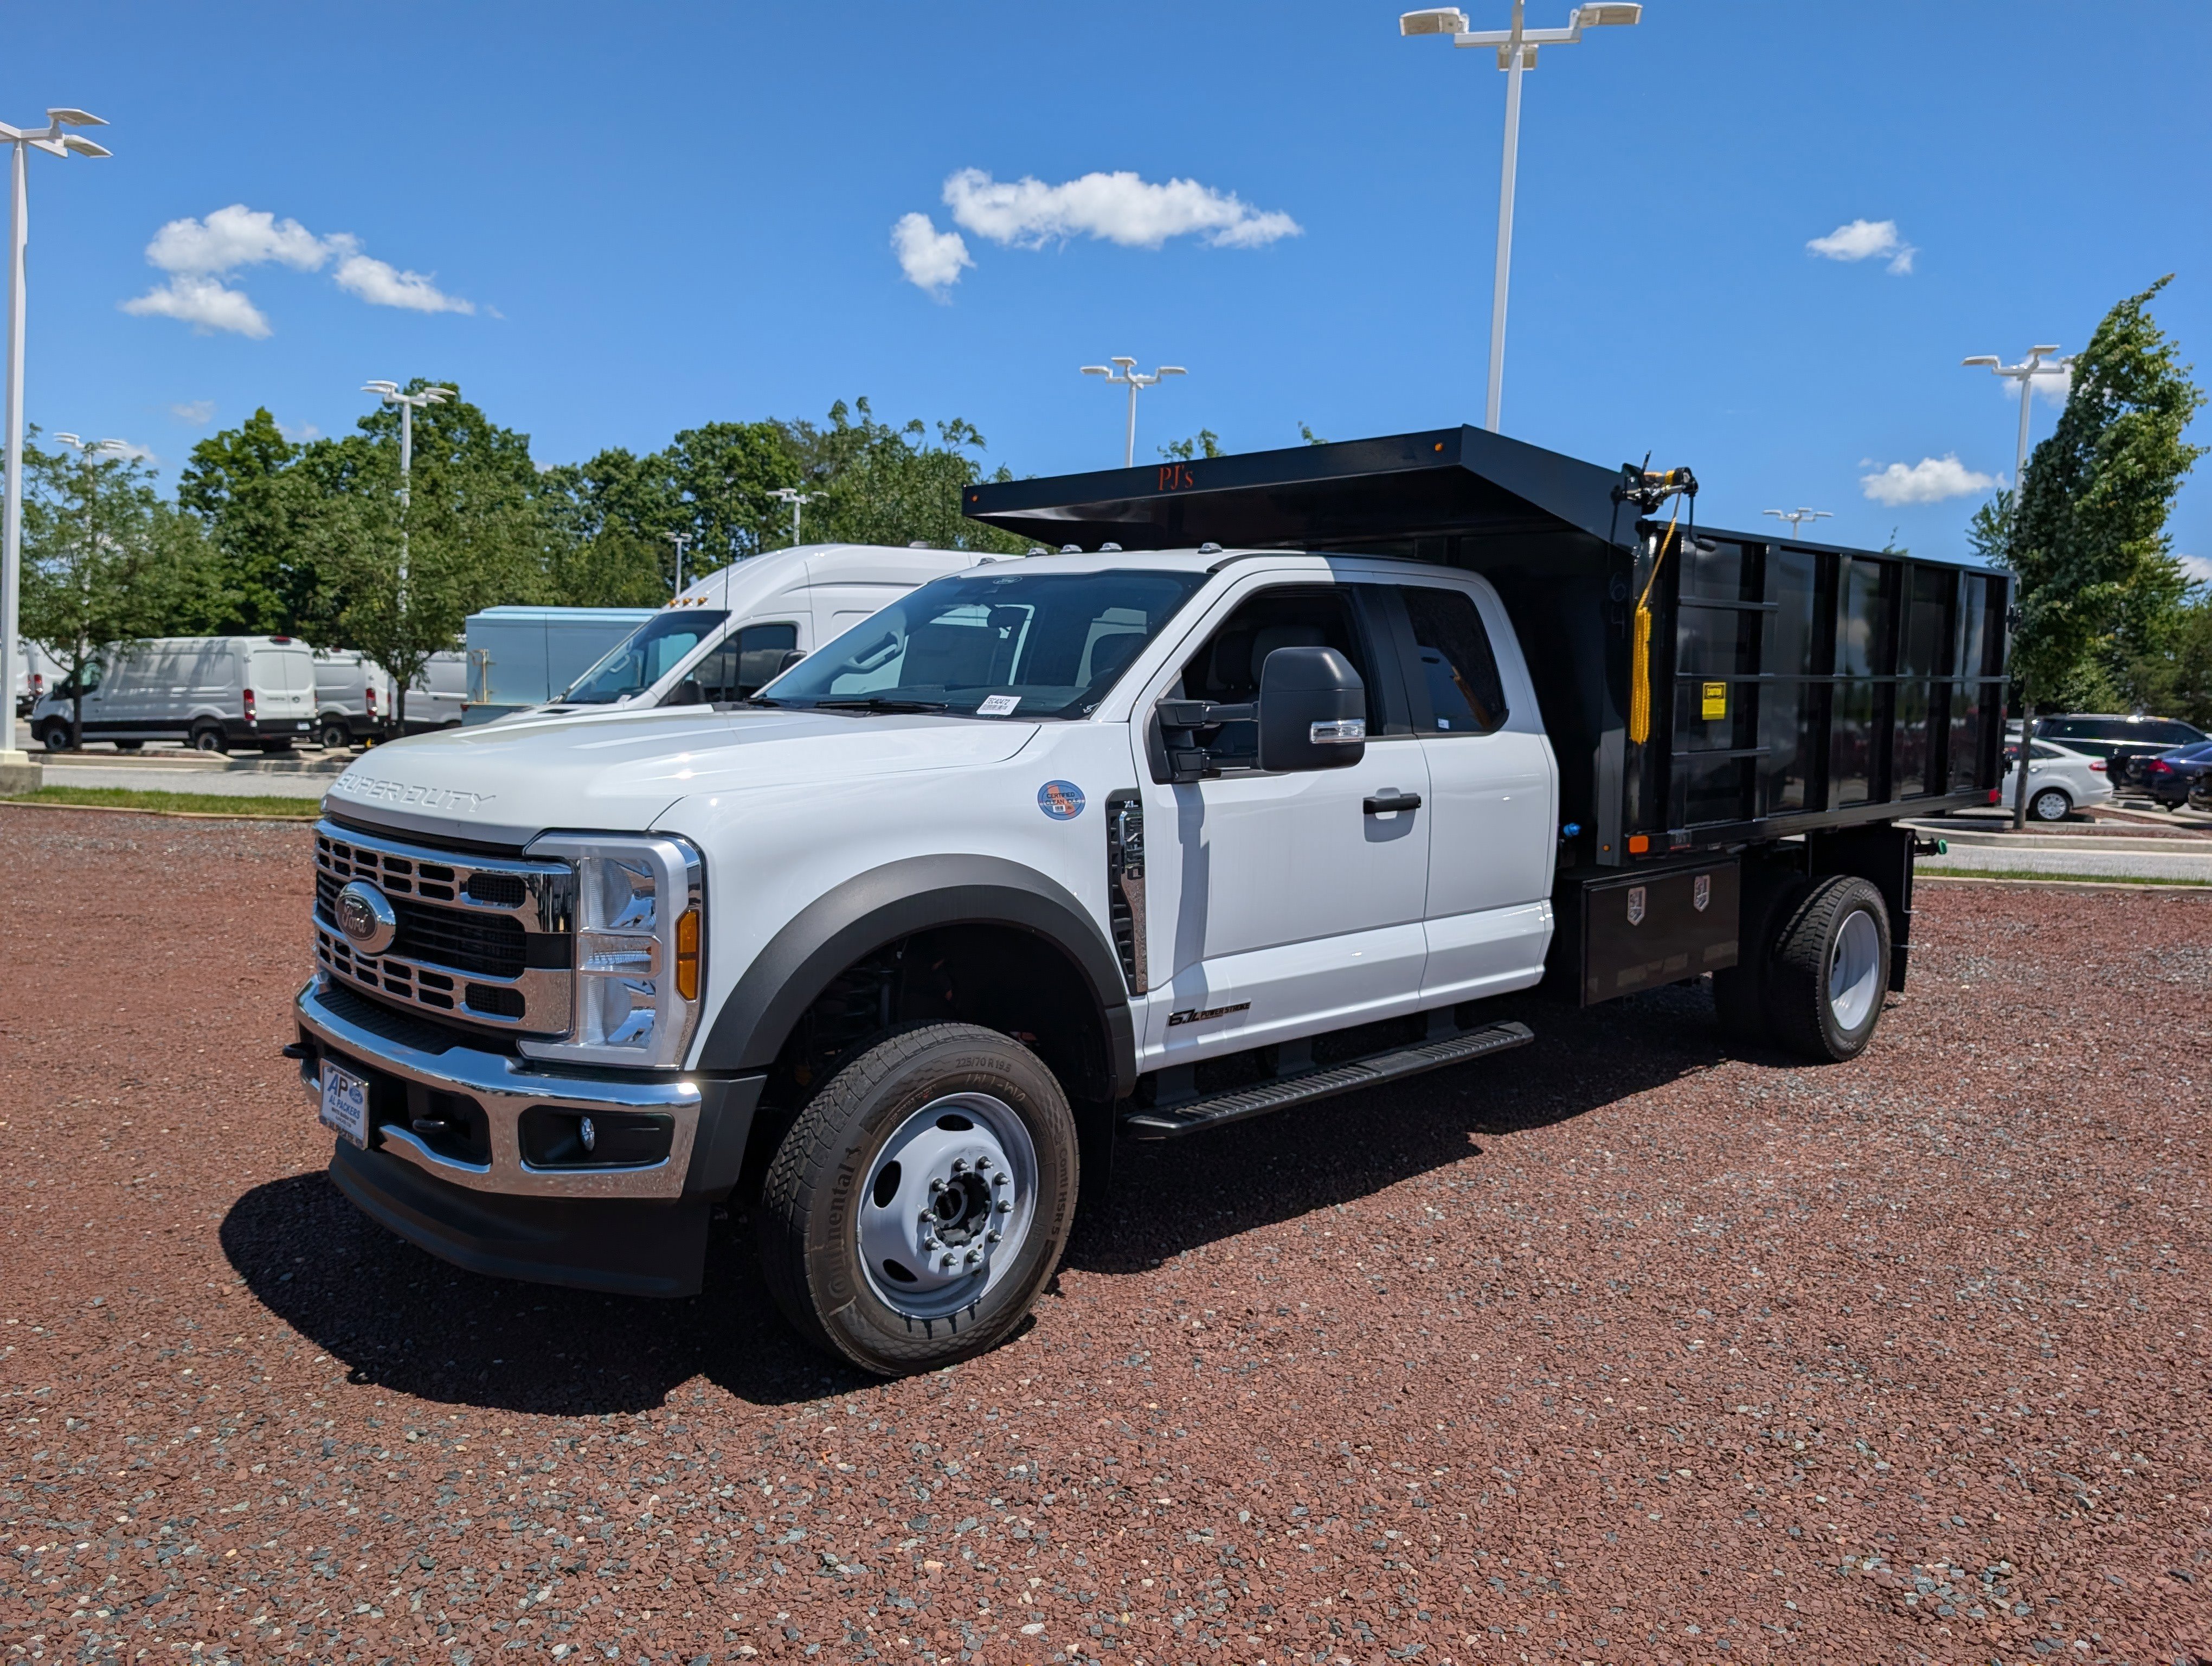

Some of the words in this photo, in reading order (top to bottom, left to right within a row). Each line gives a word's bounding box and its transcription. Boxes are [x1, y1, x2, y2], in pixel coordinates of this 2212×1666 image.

[1158, 464, 1193, 491] PJ's
[336, 773, 404, 801] SUPER
[400, 786, 496, 812] DUTY
[1123, 800, 1139, 809] XL
[1200, 1008, 1223, 1018] POWER
[1224, 1002, 1250, 1014] STROKE
[327, 1074, 348, 1097] AP
[329, 1095, 336, 1106] AL
